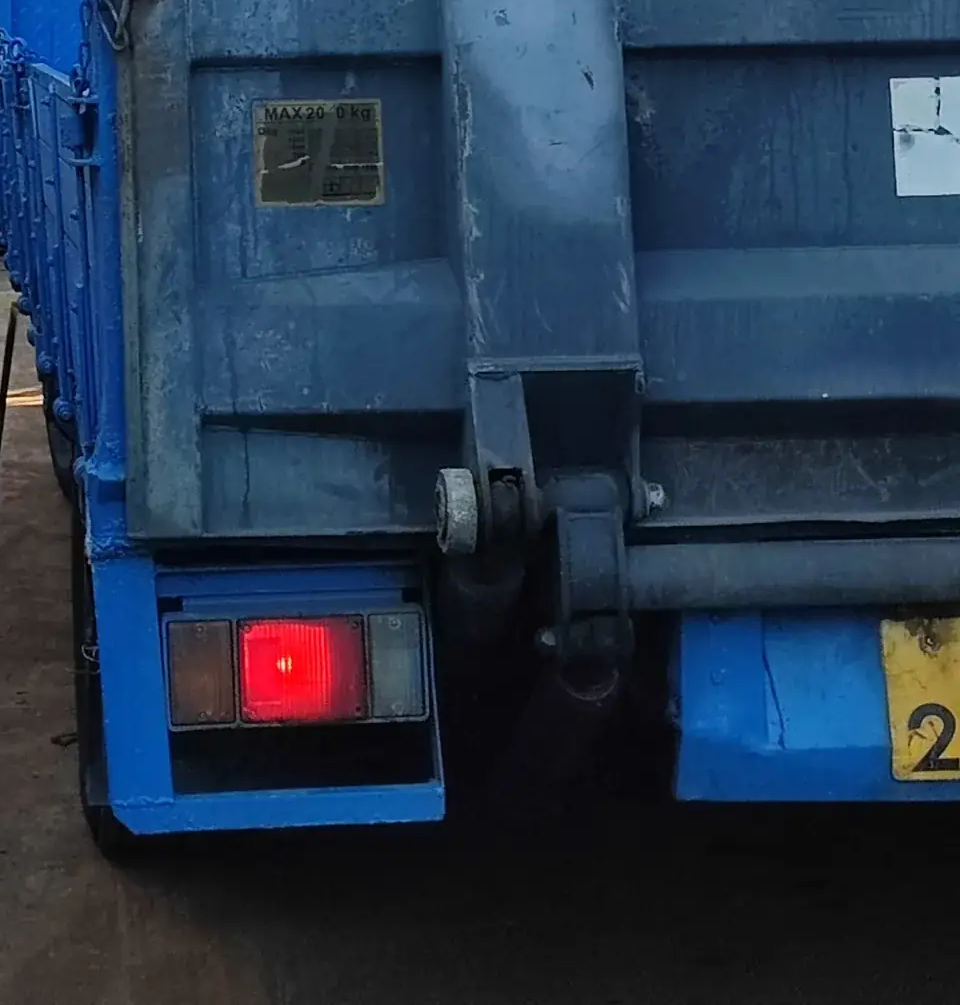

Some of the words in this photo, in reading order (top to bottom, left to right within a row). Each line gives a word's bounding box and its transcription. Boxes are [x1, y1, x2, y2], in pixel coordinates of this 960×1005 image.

[264, 106, 303, 122] MAX
[350, 104, 372, 123] kg
[907, 702, 960, 773] 2
